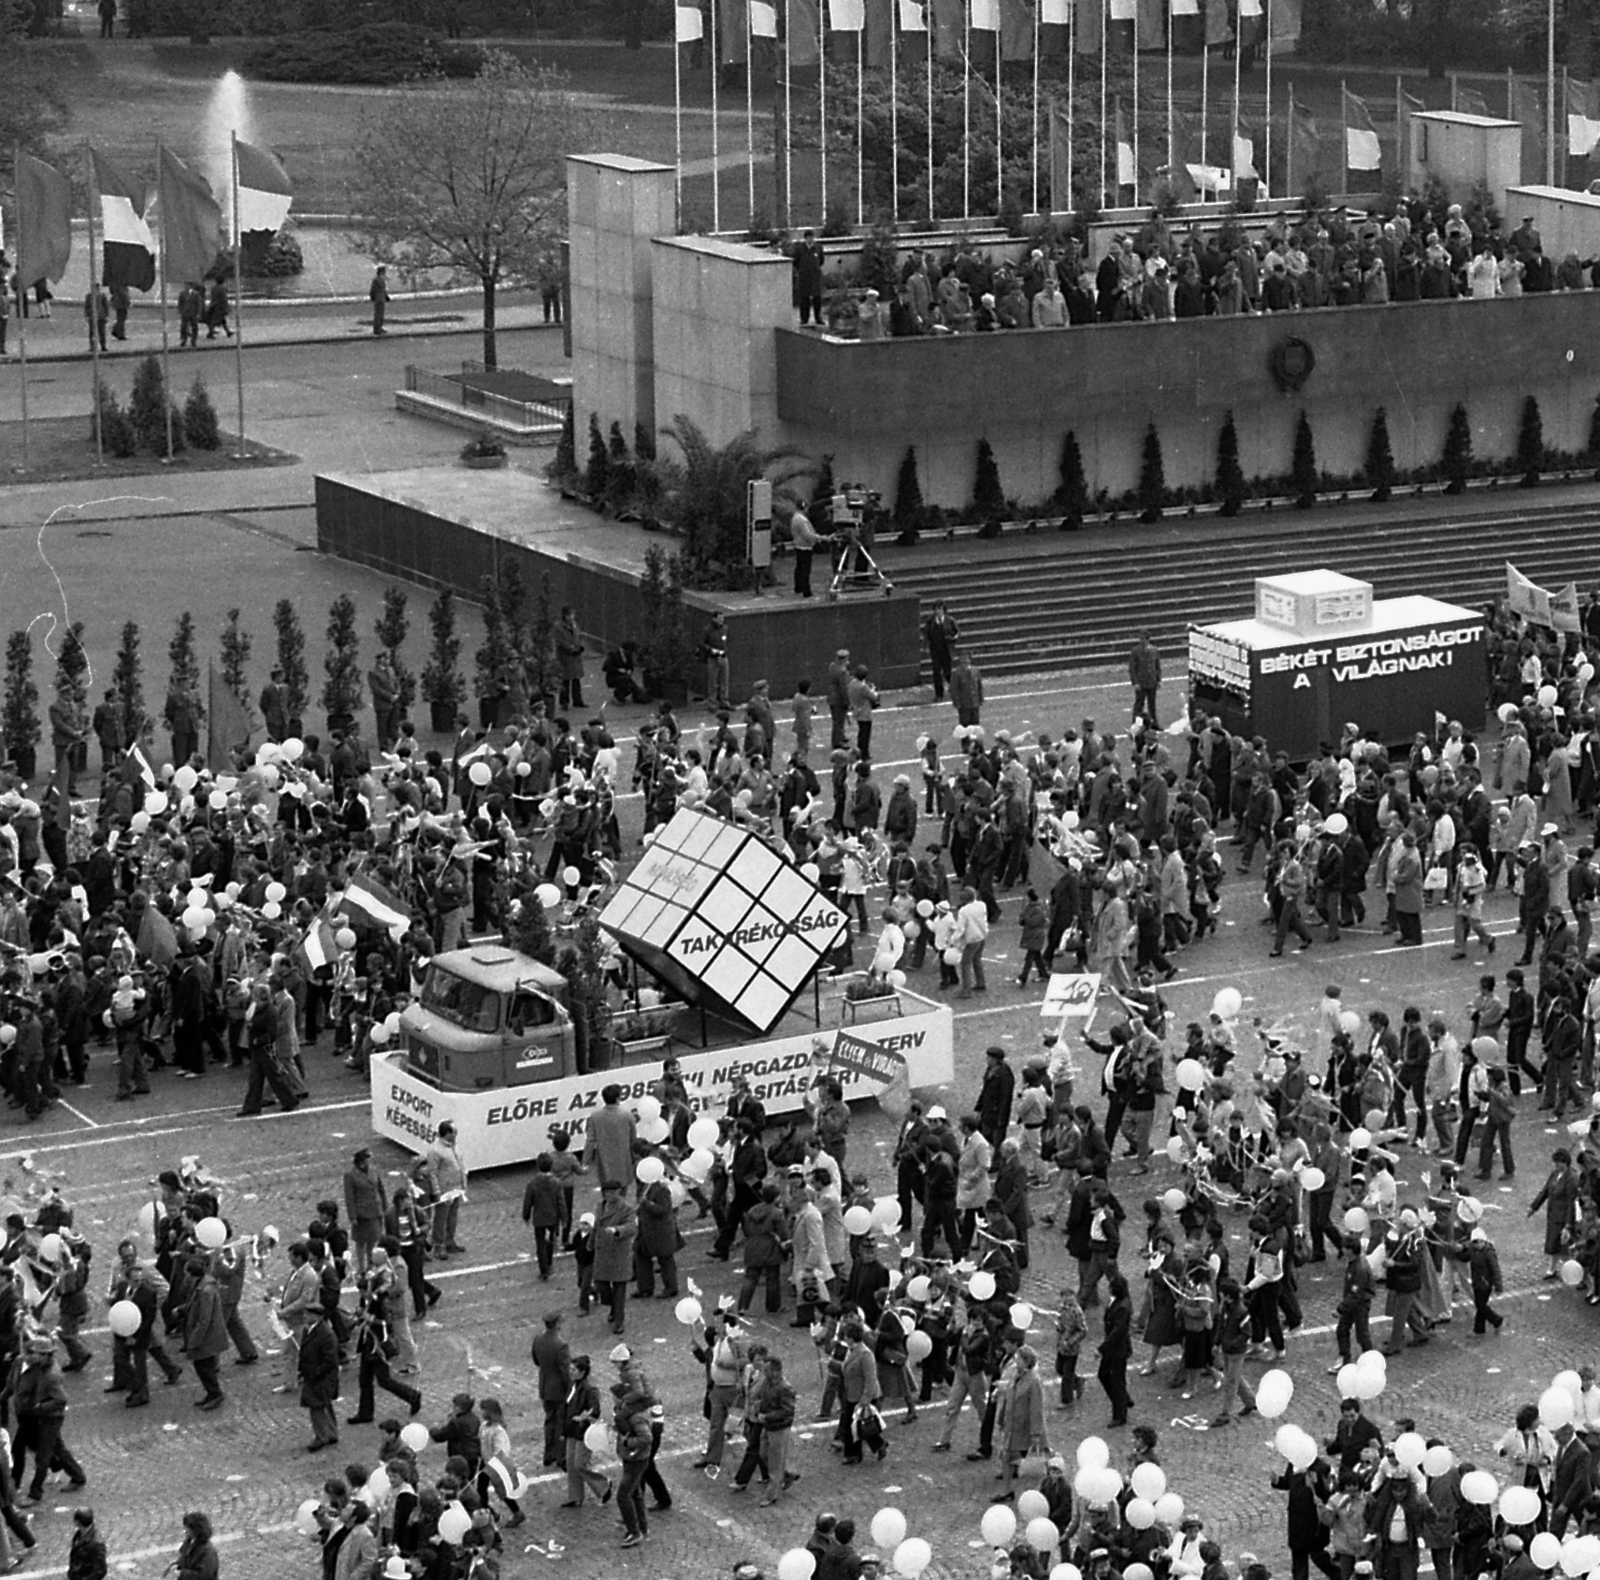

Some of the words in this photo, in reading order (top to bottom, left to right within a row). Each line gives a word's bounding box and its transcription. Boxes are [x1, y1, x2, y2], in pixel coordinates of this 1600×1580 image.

[1260, 648, 1332, 674] BÉKÉT
[1336, 626, 1484, 662] BIZTONSÁGOT
[1293, 673, 1311, 689] A
[487, 1097, 559, 1126] ELŐRE
[568, 1090, 599, 1111] AZ
[618, 1078, 660, 1103] 985
[711, 1052, 812, 1086] NÉPGAZD
[876, 1030, 926, 1053] TERV
[391, 1083, 433, 1118] EXPORT
